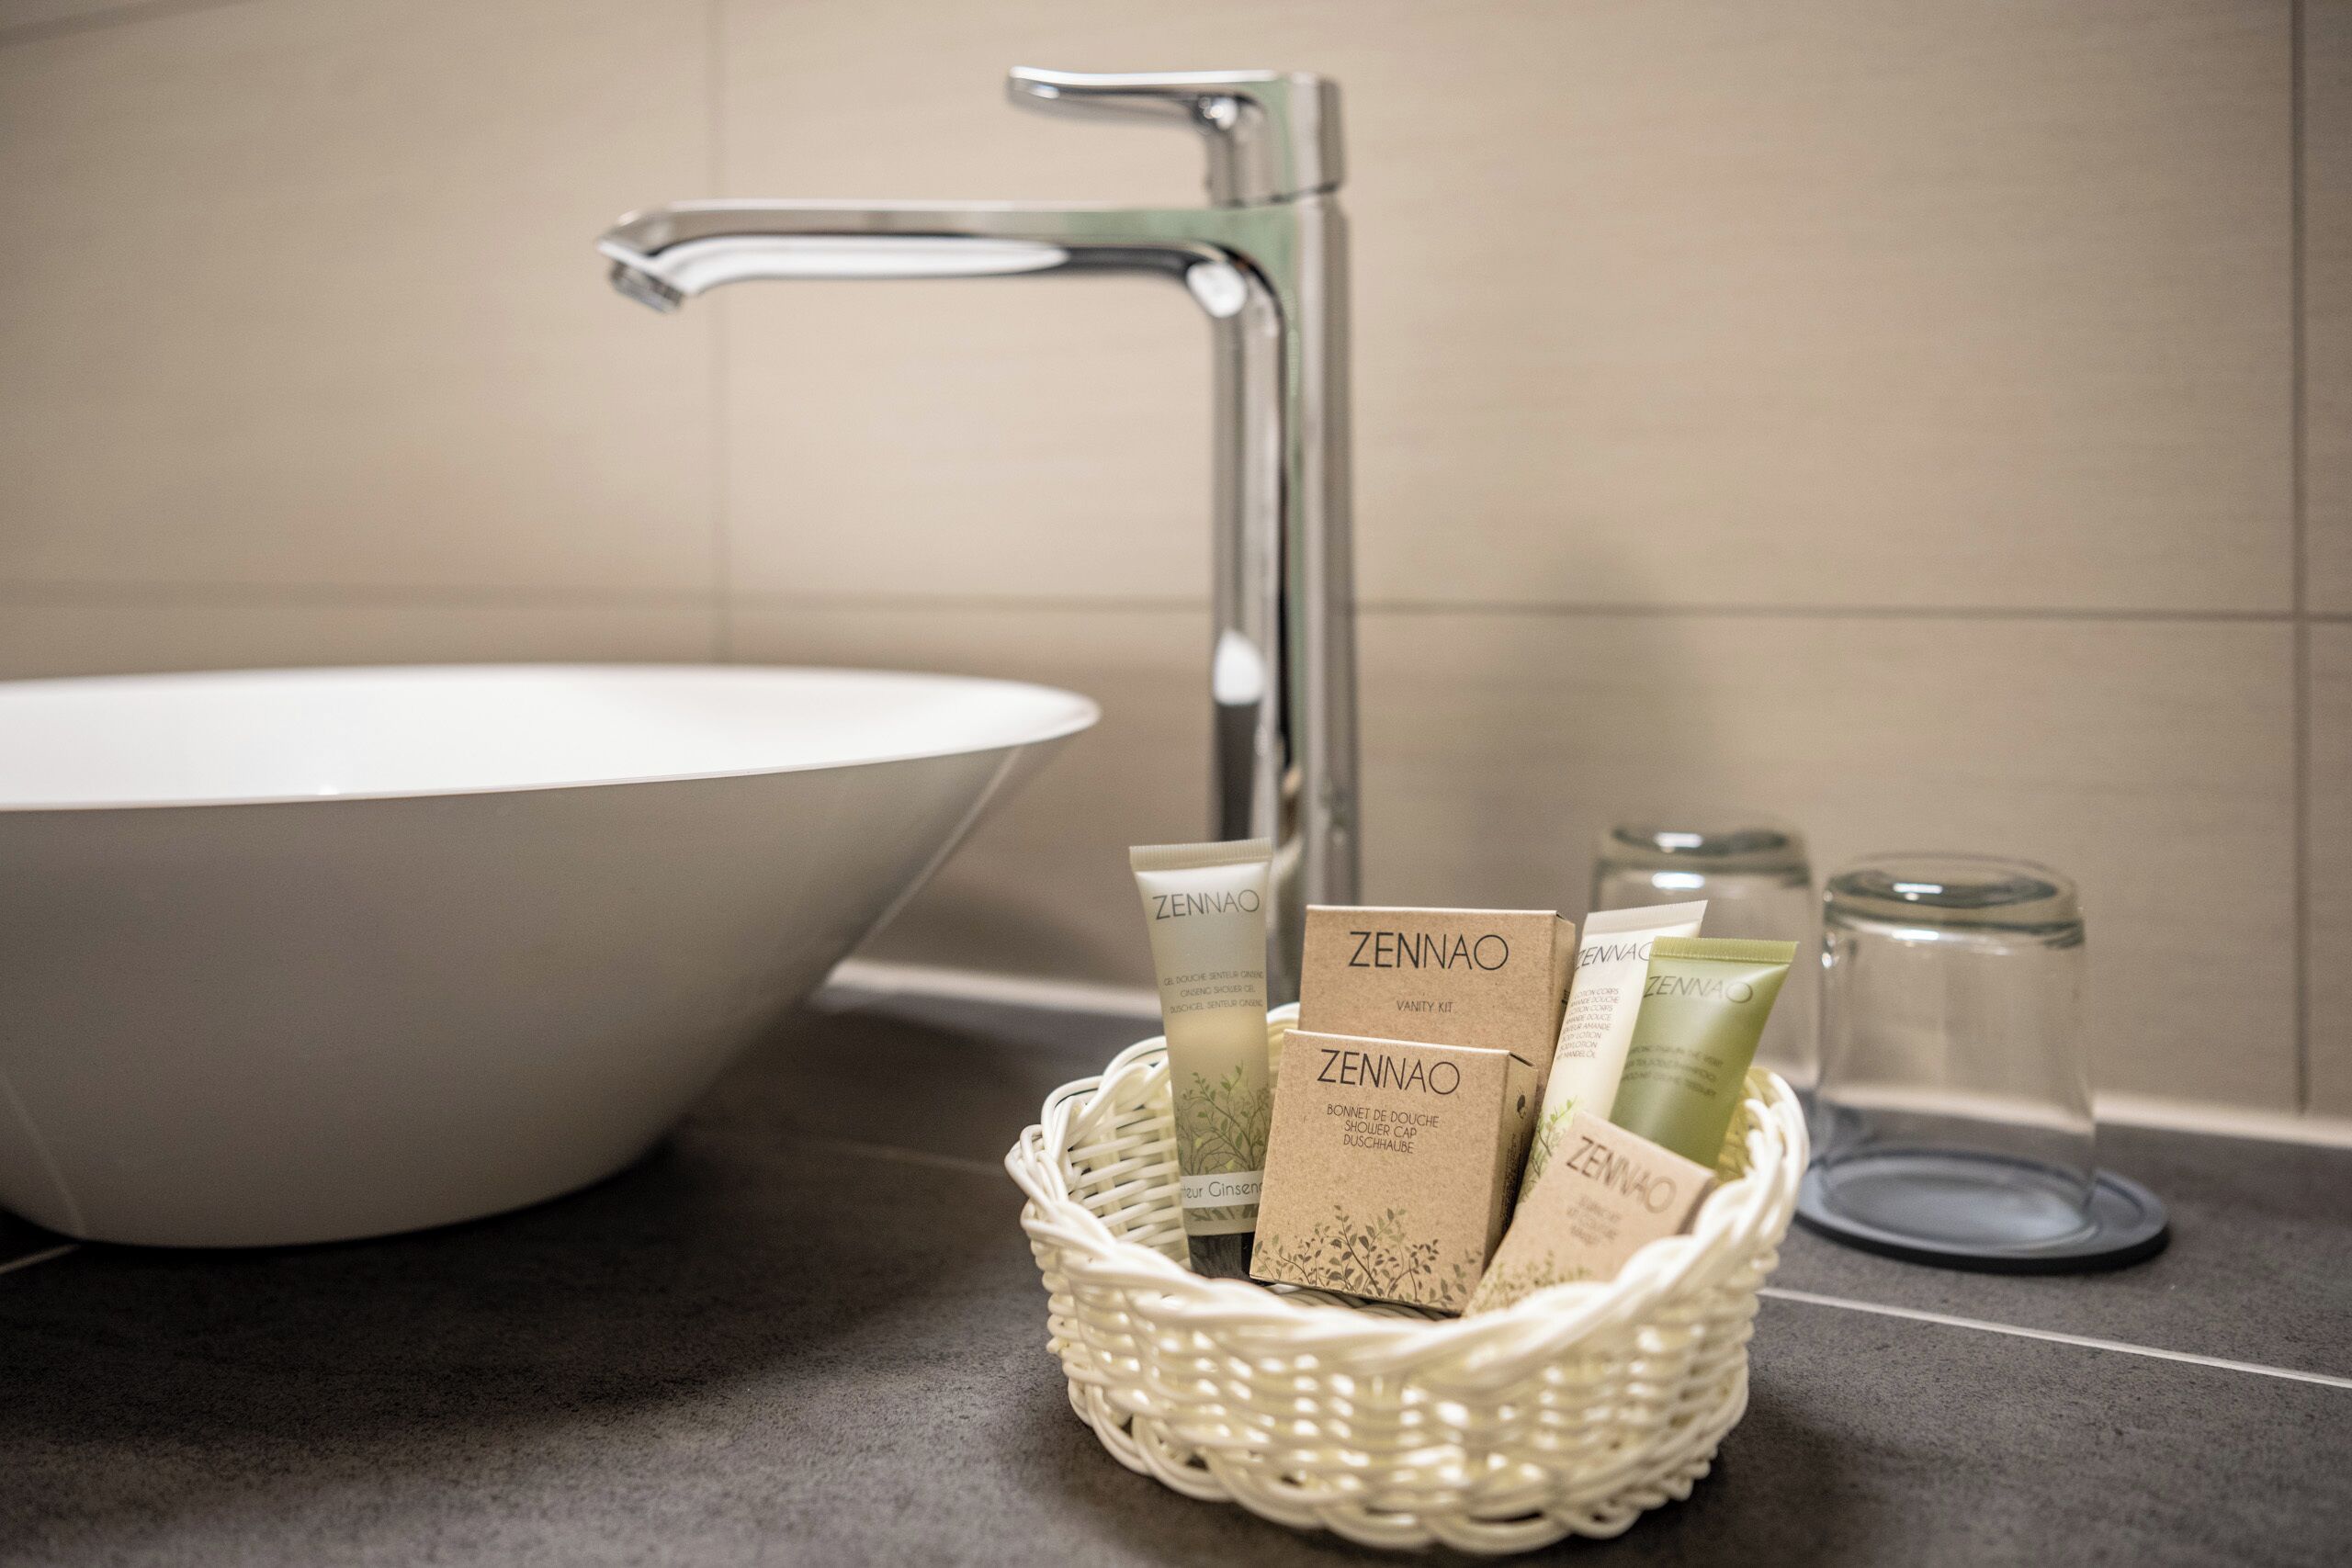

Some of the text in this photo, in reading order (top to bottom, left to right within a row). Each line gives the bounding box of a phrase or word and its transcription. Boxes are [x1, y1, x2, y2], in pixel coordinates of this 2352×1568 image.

[1152, 889, 1260, 919] ZENNAO
[1349, 931, 1509, 971] ZENNAO
[1176, 973, 1206, 984] DOUCHE
[1214, 985, 1242, 994] SHOWER
[1643, 976, 1753, 1003] ZENNAO
[1396, 1000, 1453, 1013] VANITY KIT
[1317, 1049, 1460, 1095] ZENNAO
[1327, 1104, 1440, 1128] BONNET DE DOUCHE
[1344, 1120, 1417, 1139] SHOWER CAP
[1343, 1134, 1414, 1154] DUSCHHAUBE
[1566, 1135, 1678, 1214] ZENNAO
